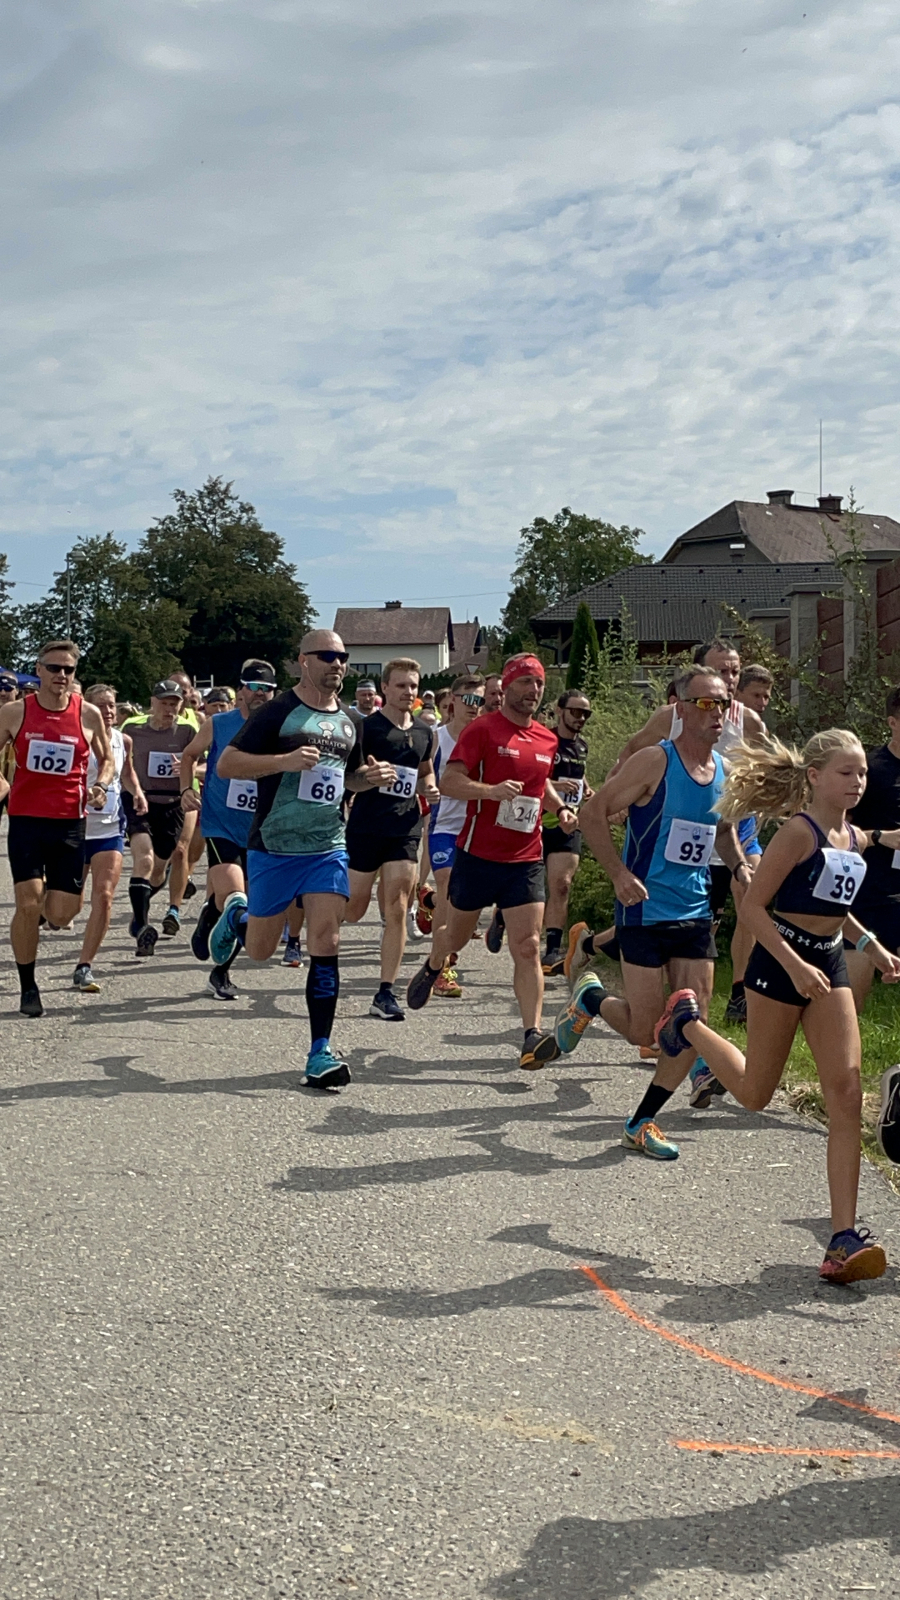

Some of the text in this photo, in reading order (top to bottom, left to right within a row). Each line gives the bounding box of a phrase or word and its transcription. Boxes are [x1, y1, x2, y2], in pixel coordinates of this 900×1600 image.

[307, 738, 347, 750] GLADIATOR
[33, 755, 67, 773] 102
[310, 782, 336, 801] 68
[236, 793, 258, 810] 98
[513, 806, 537, 824] 246
[679, 841, 706, 863] 93
[829, 874, 856, 901] 39
